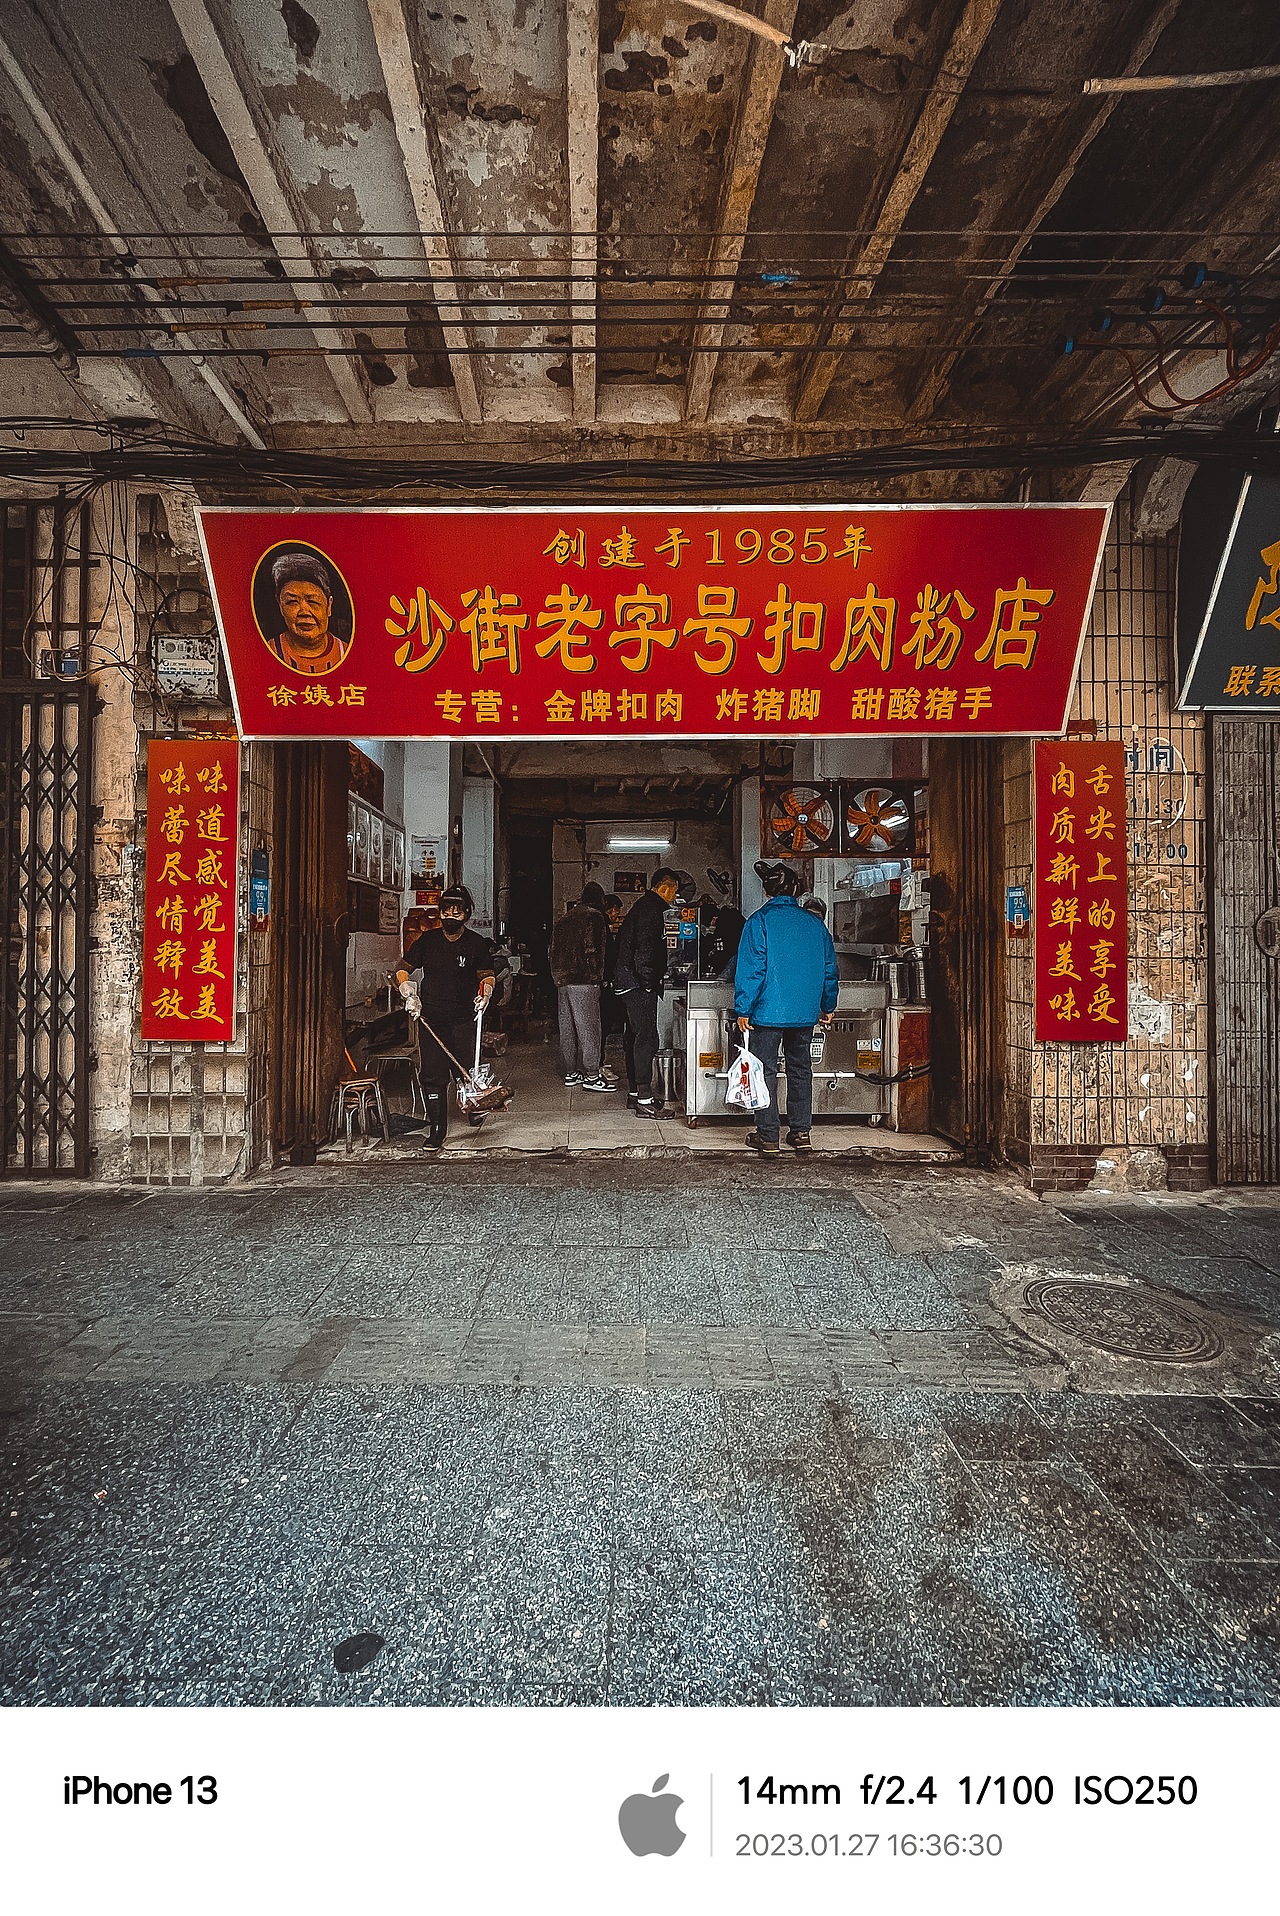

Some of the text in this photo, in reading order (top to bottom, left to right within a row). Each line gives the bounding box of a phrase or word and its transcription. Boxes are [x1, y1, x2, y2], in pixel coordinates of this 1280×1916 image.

[384, 576, 1055, 674] 沙街老字号扣肉粉店
[543, 524, 872, 569] 创建于1985年
[267, 683, 368, 707] 徐姨店
[544, 688, 683, 722] 金牌扣肉
[716, 687, 821, 721] 炸猪脚
[852, 686, 993, 720] 甜酸猪手
[151, 761, 191, 1020] 味蕾尽情释放
[192, 760, 229, 1024] 味道感觉美美
[1045, 762, 1082, 1022] 肉质新鲜美味
[1085, 764, 1120, 1024] 舌尖上的享受
